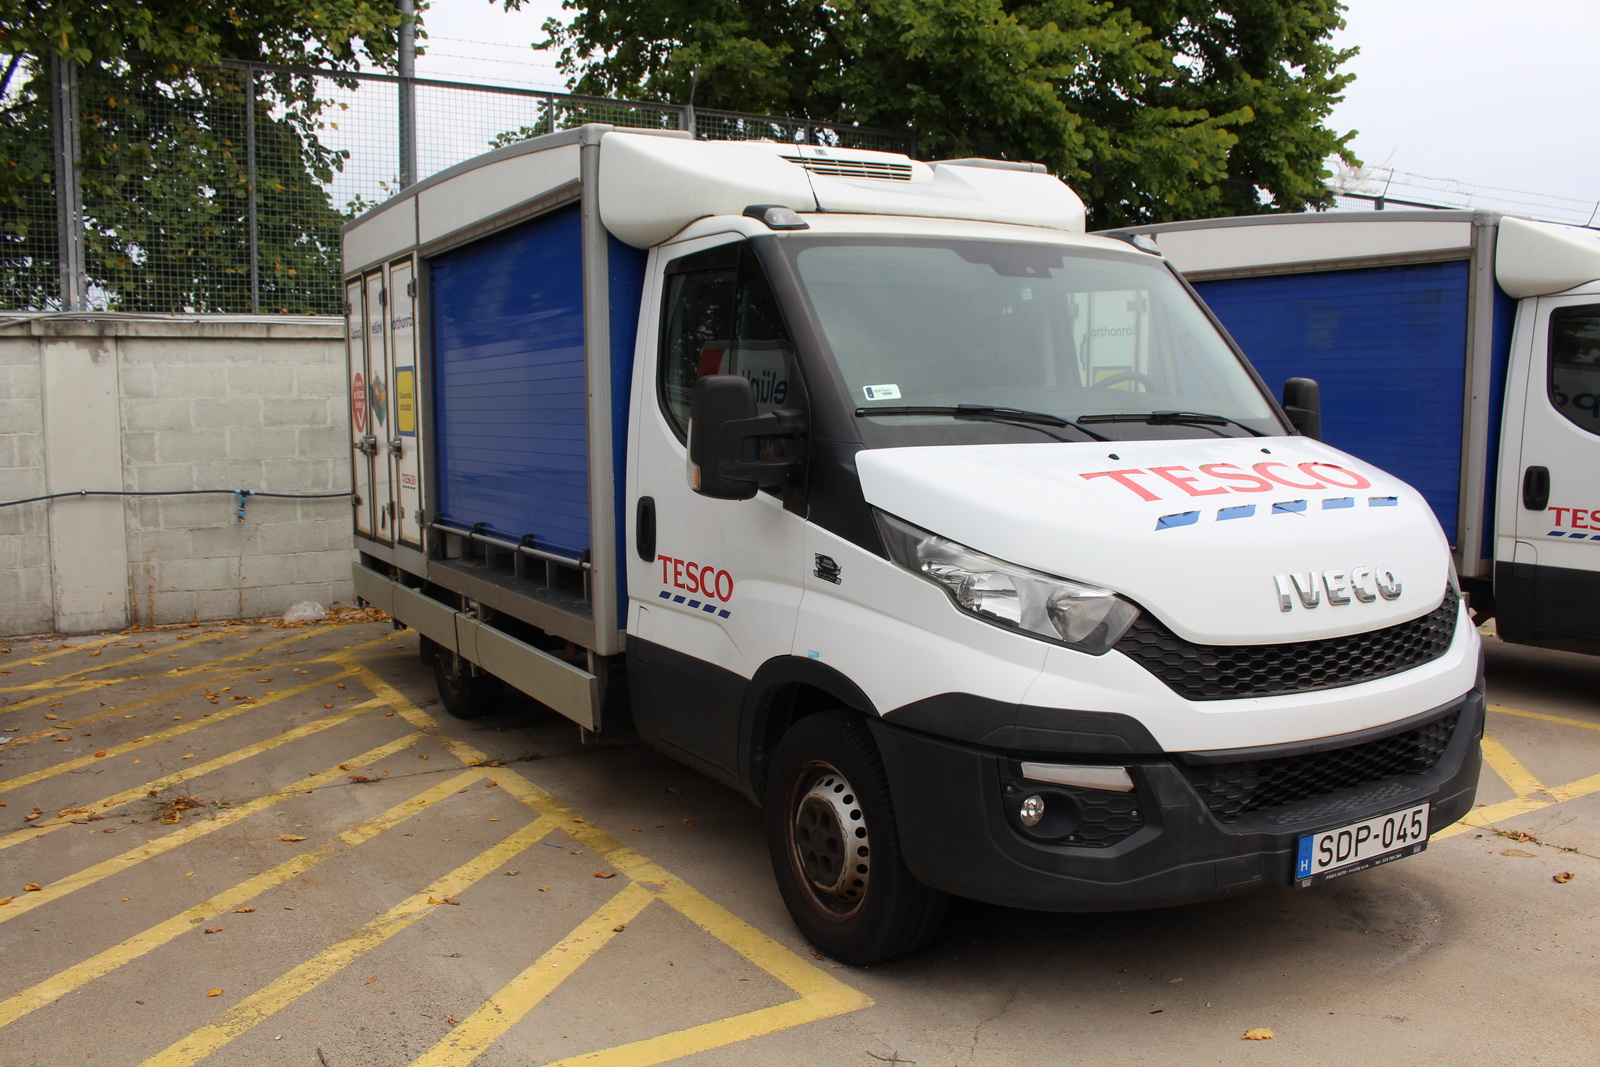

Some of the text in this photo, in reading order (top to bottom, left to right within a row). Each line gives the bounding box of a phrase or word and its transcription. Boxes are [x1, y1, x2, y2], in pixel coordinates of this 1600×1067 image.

[1078, 462, 1371, 502] TESCO
[657, 554, 734, 603] TESCO
[1273, 564, 1402, 612] IVECO
[1317, 808, 1423, 867] SDP-045
